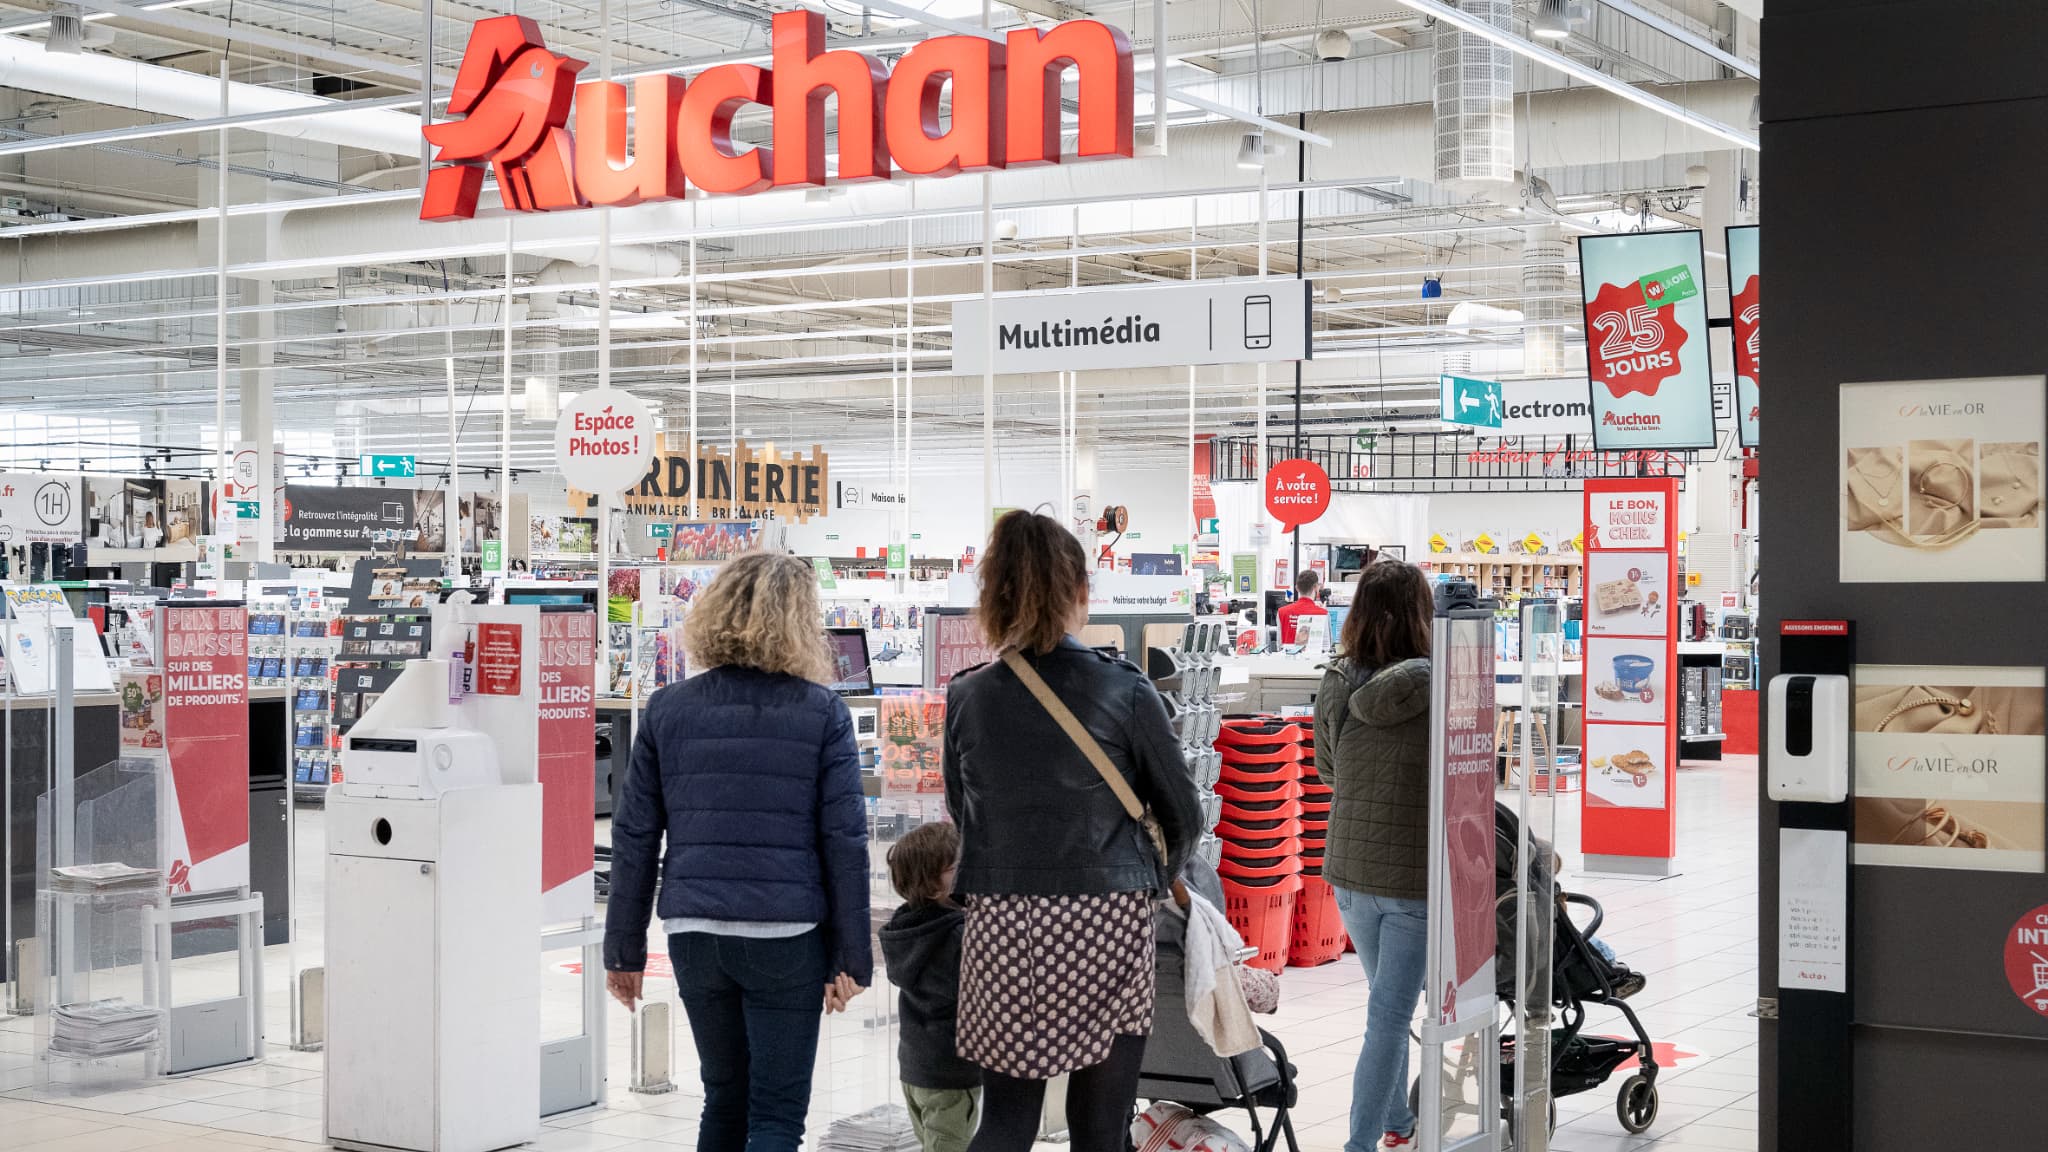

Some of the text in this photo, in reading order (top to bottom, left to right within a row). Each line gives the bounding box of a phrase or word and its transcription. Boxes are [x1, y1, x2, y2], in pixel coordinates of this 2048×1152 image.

[420, 10, 1134, 222] Auchan
[999, 315, 1161, 351] Multimédia
[1592, 304, 1665, 361] 25
[1604, 350, 1674, 378] JOURS
[1502, 400, 1592, 419] lectrom
[1602, 410, 1661, 425] Auchan
[1928, 404, 1952, 416] VIE
[1964, 402, 1985, 416] OR
[575, 412, 635, 436] Espace
[570, 435, 639, 457] Photos !
[625, 456, 821, 505] RDINERIE
[1275, 477, 1317, 491] À votre
[0, 485, 15, 497] .fr
[871, 492, 896, 503] Maison
[1274, 493, 1313, 504] service
[41, 493, 63, 515] 1H
[1609, 499, 1659, 511] LE BON,
[298, 510, 378, 522] Retrouvez l'intégralité
[1609, 511, 1658, 525] MOINS
[289, 524, 301, 537] la
[303, 527, 341, 540] gamme
[344, 528, 360, 539] sur
[1609, 527, 1652, 541] CHER.
[168, 609, 244, 631] PRIX EN
[567, 615, 592, 638] EN
[940, 619, 978, 645] PRIX
[168, 632, 245, 657] BAISSE
[539, 640, 592, 667] AISSE
[167, 661, 213, 673] SUR DES
[168, 674, 244, 692] MILLIERS
[541, 672, 562, 684] DES
[168, 695, 183, 707] DE
[540, 686, 591, 704] LLIERS
[1449, 715, 1477, 731] SUR DES
[1449, 733, 1493, 757] MILLIERS
[1448, 762, 1457, 776] DE
[1925, 757, 1954, 773] VIE
[1971, 758, 1999, 774] OR
